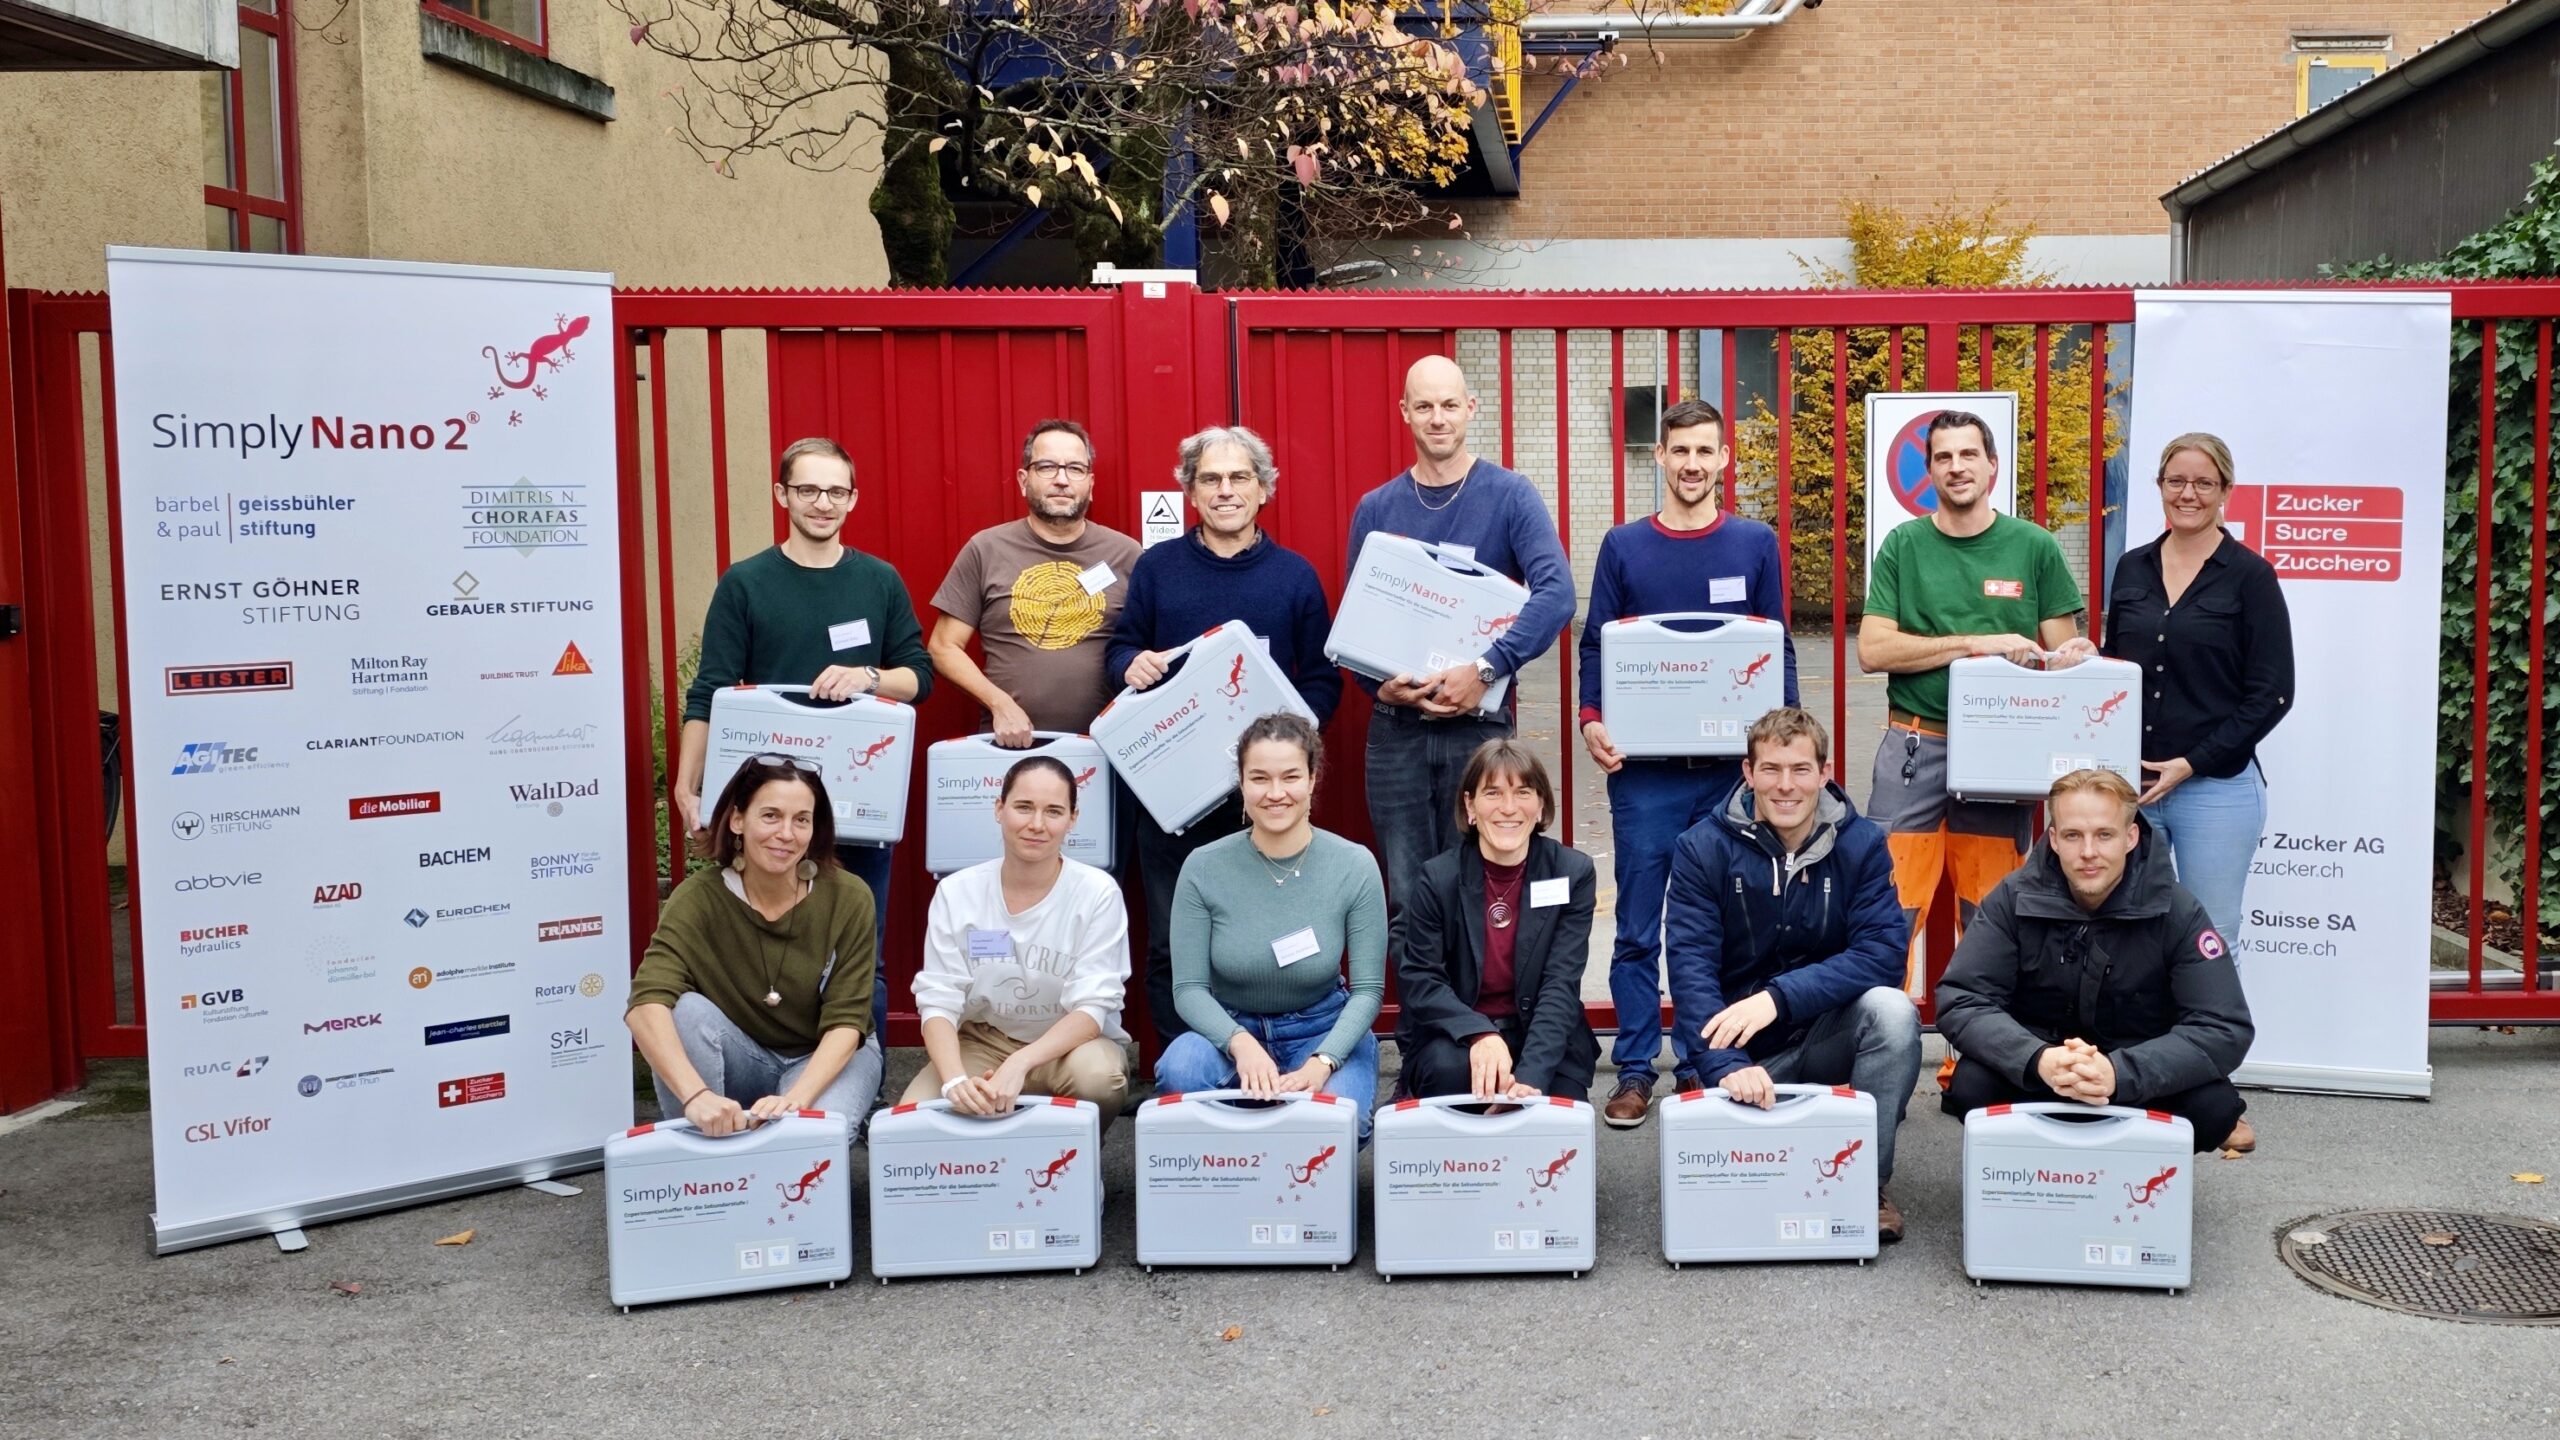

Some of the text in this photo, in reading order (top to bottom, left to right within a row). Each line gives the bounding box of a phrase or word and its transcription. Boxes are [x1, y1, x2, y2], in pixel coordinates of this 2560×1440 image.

[155, 495, 220, 512] bärbel
[238, 494, 356, 515] geissbühler
[471, 490, 553, 504] DIMITRIS
[2276, 493, 2364, 512] Zucker
[471, 509, 578, 525] CHORAFAS
[157, 521, 221, 541] & paul
[239, 520, 316, 538] stiftung
[472, 529, 579, 545] FOUNDATION
[1150, 525, 1176, 534] Video
[2275, 523, 2348, 542] Sucre
[2273, 553, 2392, 573] Zucchero
[161, 577, 360, 601] ERNST GÖHNER
[242, 603, 360, 625] STIFTUNG
[426, 600, 594, 617] GEBAUER STIFTUNG
[351, 655, 428, 670] Milton Ray
[557, 651, 588, 673] Sika
[174, 669, 285, 688] LEISTER
[352, 671, 428, 684] Hartmann
[480, 671, 540, 680] BUILDING TRUST
[352, 687, 384, 696] Stiftung
[210, 806, 300, 823] HIRSCHMANN
[379, 798, 431, 813] Mobiliar
[210, 819, 273, 835] STIFTUNG
[2273, 832, 2348, 853] Zucker
[2353, 836, 2386, 855] AG
[419, 846, 491, 868] BACHEM
[531, 852, 580, 868] BONNY
[531, 863, 594, 880] STIFTUNG
[175, 870, 262, 892] abbvie
[313, 882, 363, 904] AZAD
[540, 920, 602, 938] FRANKE
[2251, 909, 2320, 930] Suisse
[2327, 914, 2357, 932] SA
[180, 923, 249, 943] BUCHER
[180, 939, 241, 957] hydraulics
[201, 988, 244, 1006] GVB
[535, 983, 576, 999] Rotary
[303, 1012, 383, 1036] MERCK
[184, 1060, 232, 1078] RUAG
[184, 1115, 272, 1143] CSL Vifor
